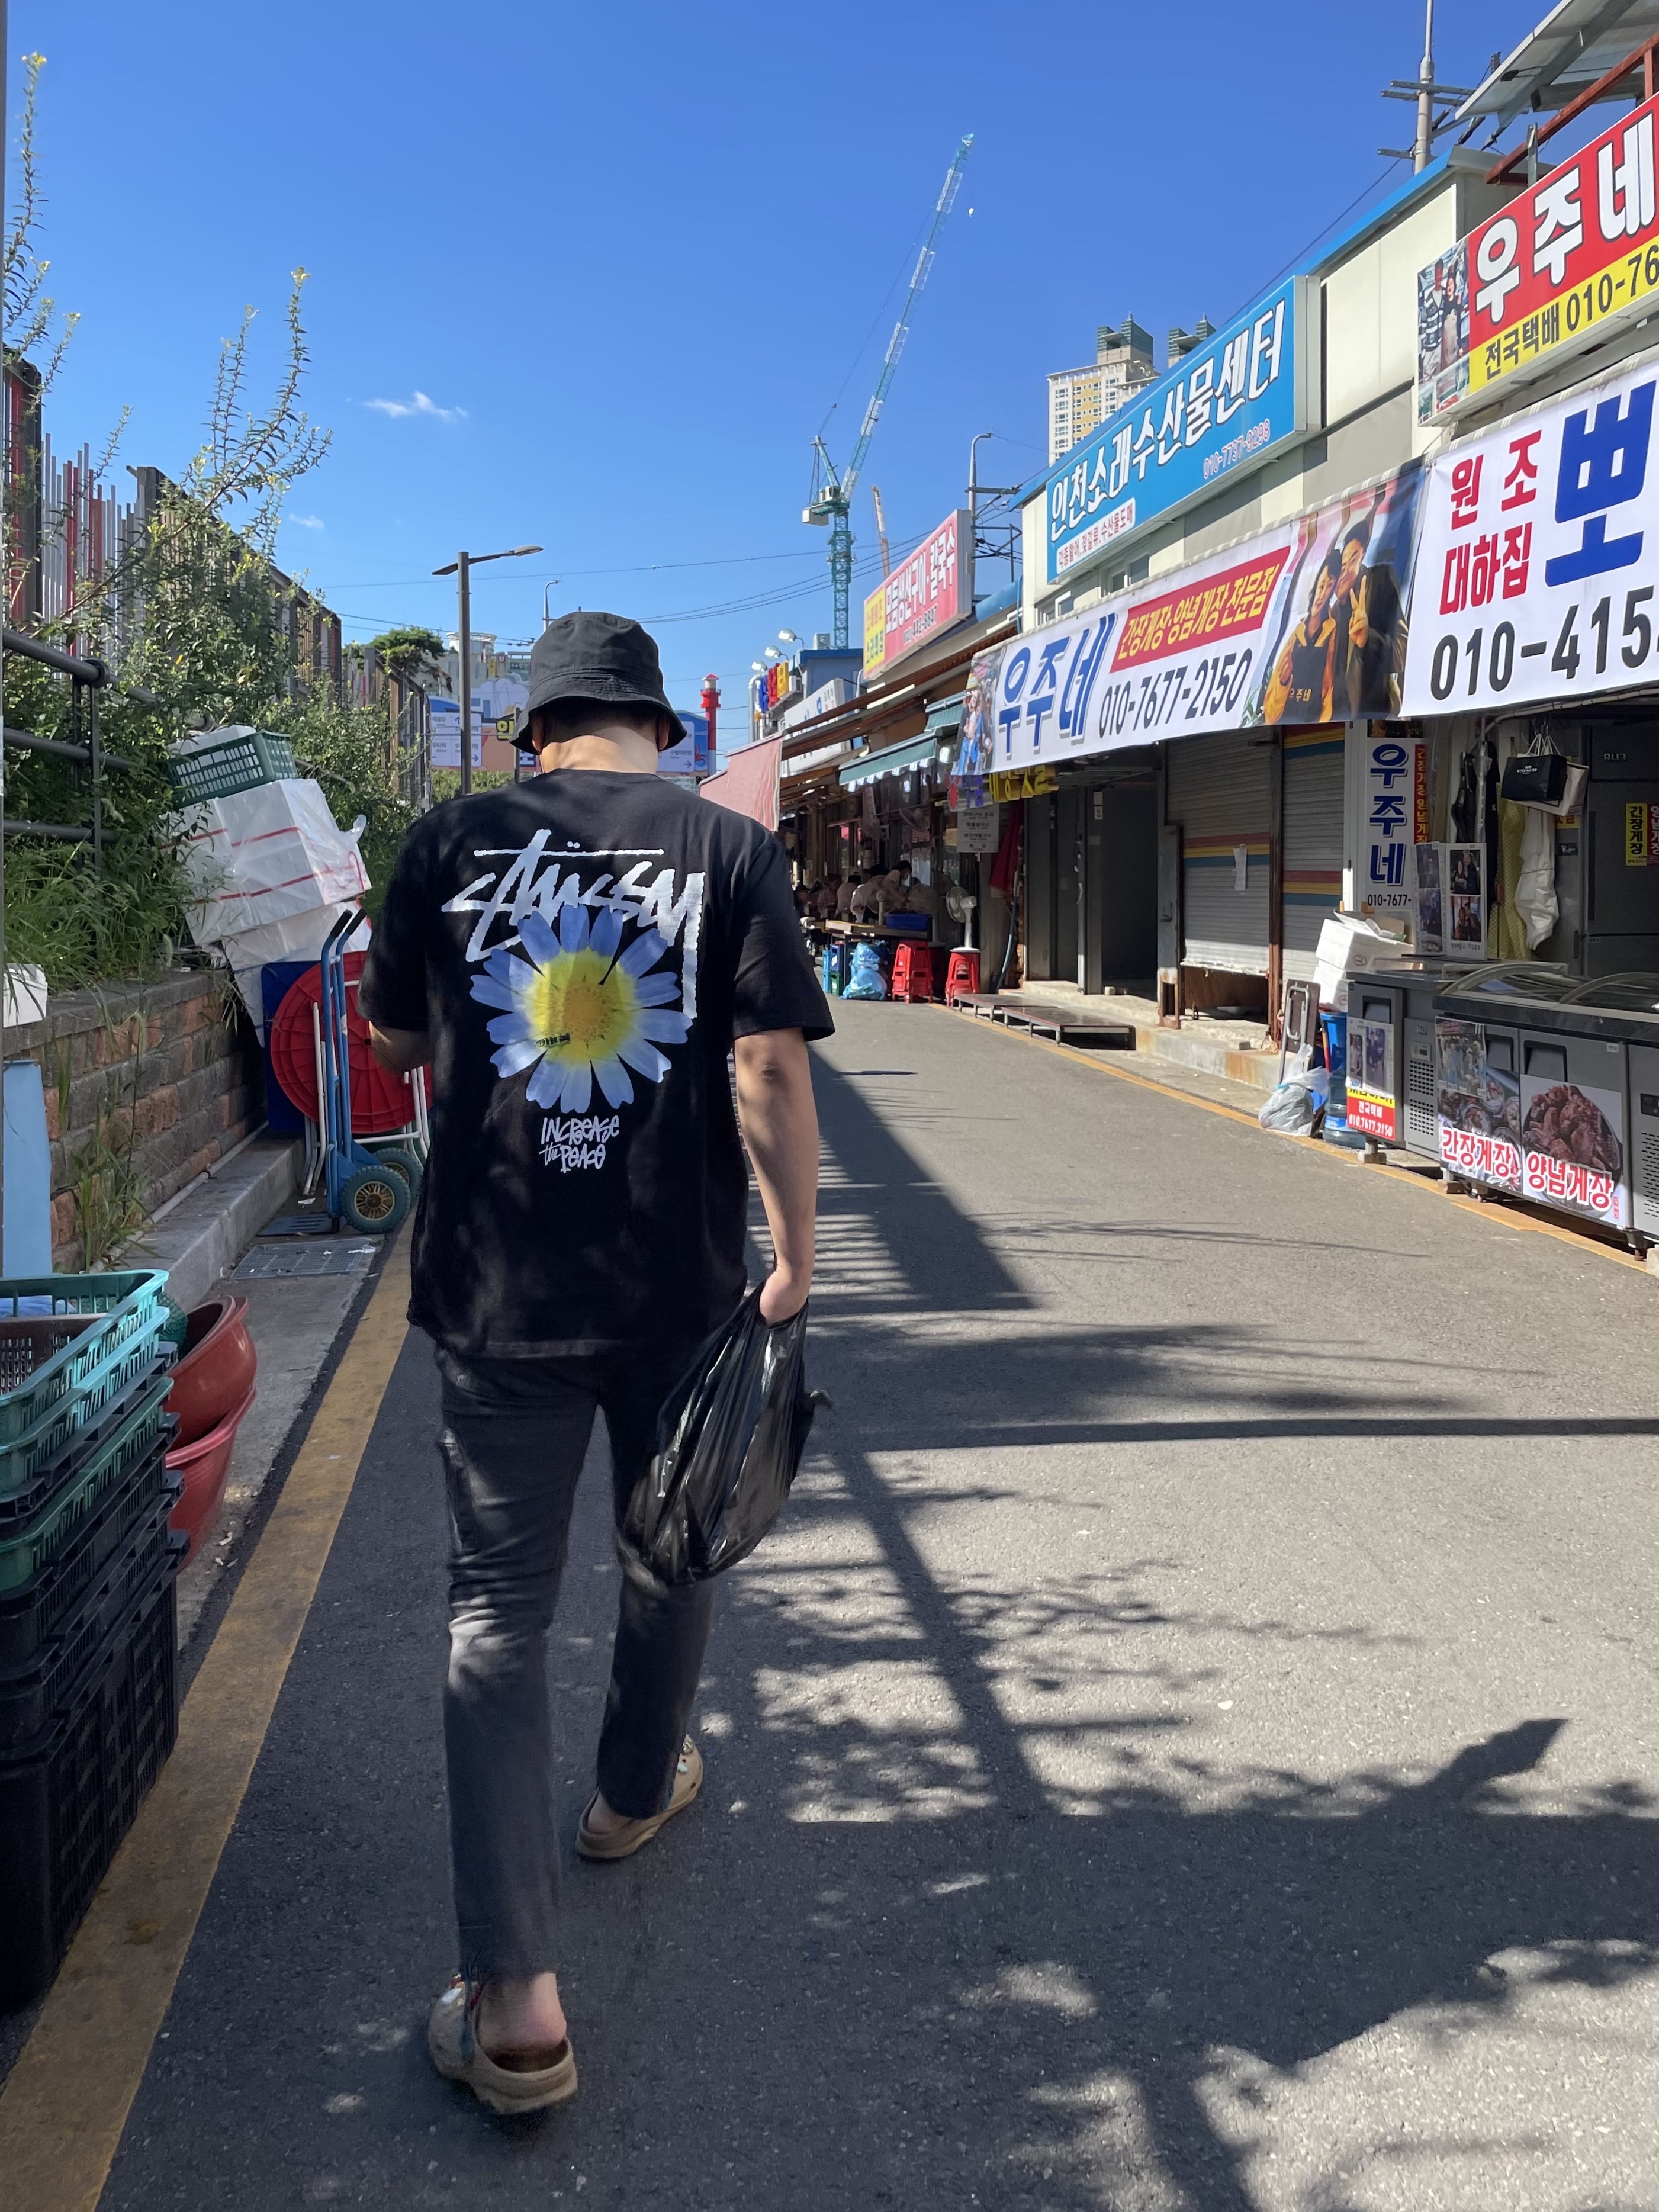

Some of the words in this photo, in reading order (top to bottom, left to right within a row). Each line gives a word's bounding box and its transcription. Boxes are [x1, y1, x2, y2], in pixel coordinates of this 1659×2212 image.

[1475, 110, 1656, 324] 우주네
[1484, 301, 1560, 380] 전국택배
[1566, 244, 1659, 332] 010-76
[1050, 297, 1286, 542] 인천소래수산물센터
[1203, 418, 1270, 479] 010-7737-9298
[1545, 380, 1657, 587] 뽀
[1219, 563, 1280, 627] 전문점
[1439, 521, 1533, 615] 대하집
[998, 612, 1118, 759] 우주네
[1430, 584, 1659, 701] 010-415
[1099, 648, 1253, 739] 010-7677-2150
[1369, 744, 1408, 886] 우주네
[1629, 806, 1644, 855] 간장게장
[1358, 1101, 1383, 1118] 전국택배
[1441, 1127, 1512, 1178] 간장게장
[1528, 1153, 1613, 1210] 양념게장
